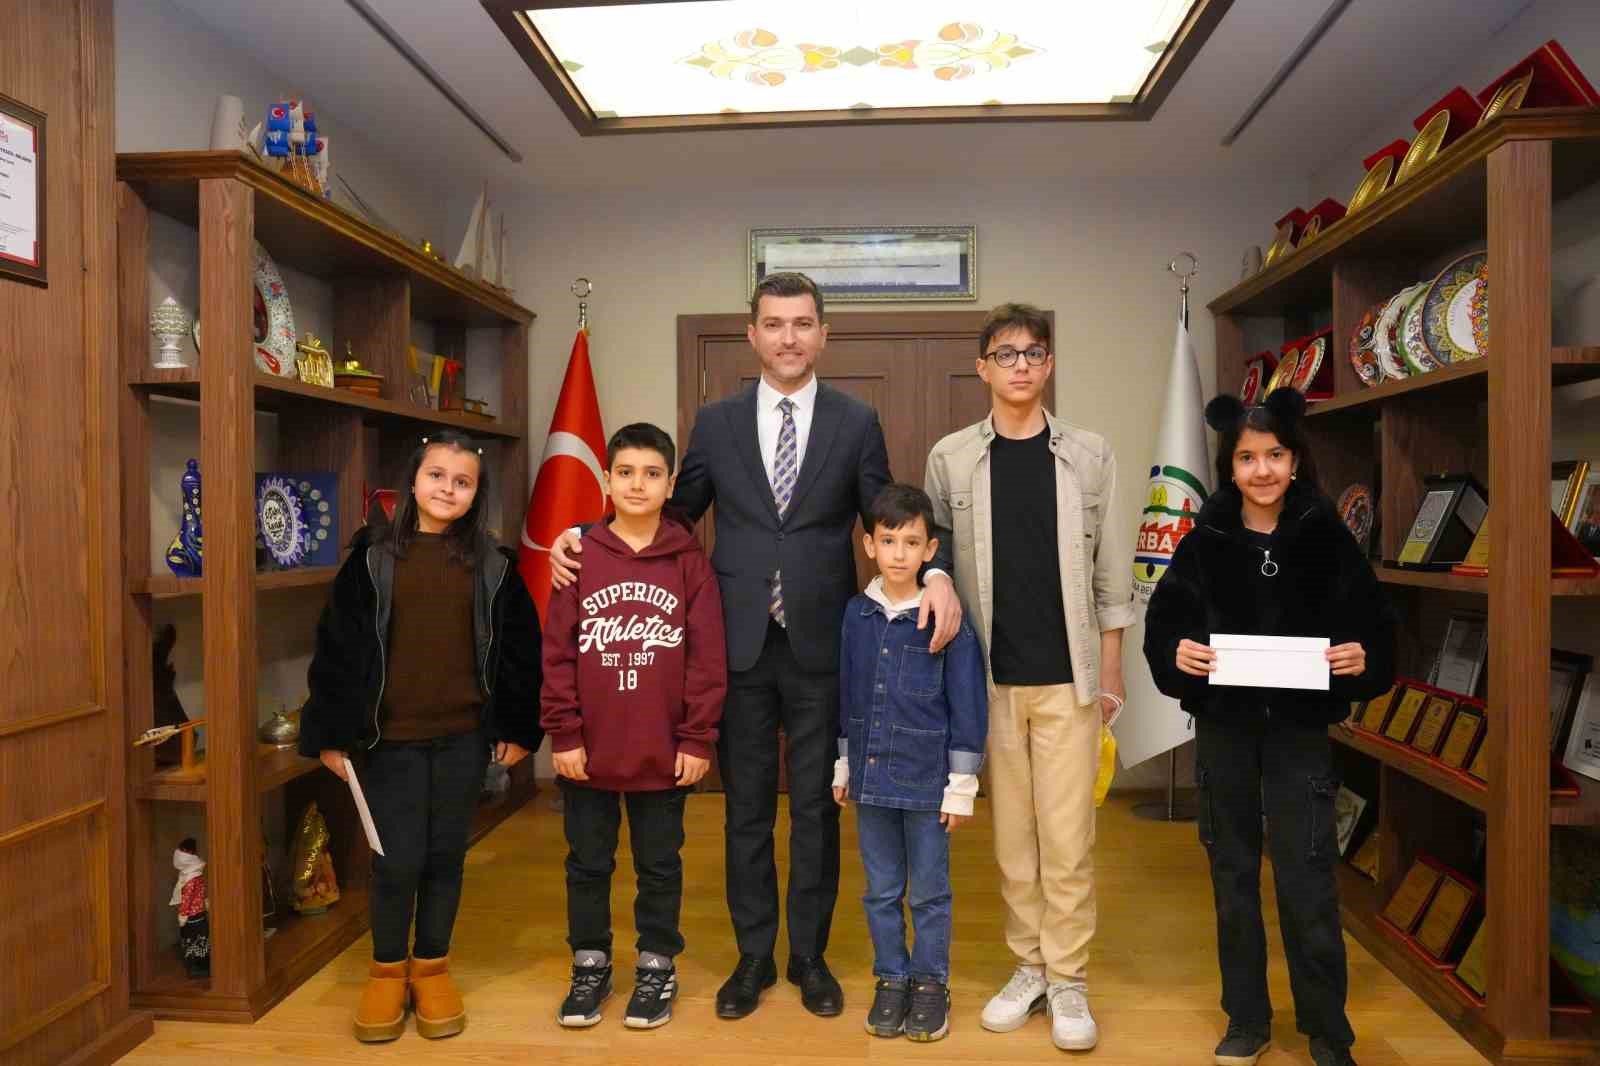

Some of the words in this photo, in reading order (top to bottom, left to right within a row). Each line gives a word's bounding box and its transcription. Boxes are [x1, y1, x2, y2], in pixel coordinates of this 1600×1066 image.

[1138, 530, 1174, 553] RBA
[582, 582, 679, 616] SUPERIOR
[579, 614, 683, 653] Athletics
[601, 653, 623, 667] EST.
[628, 652, 655, 667] 1997
[618, 669, 638, 691] 18
